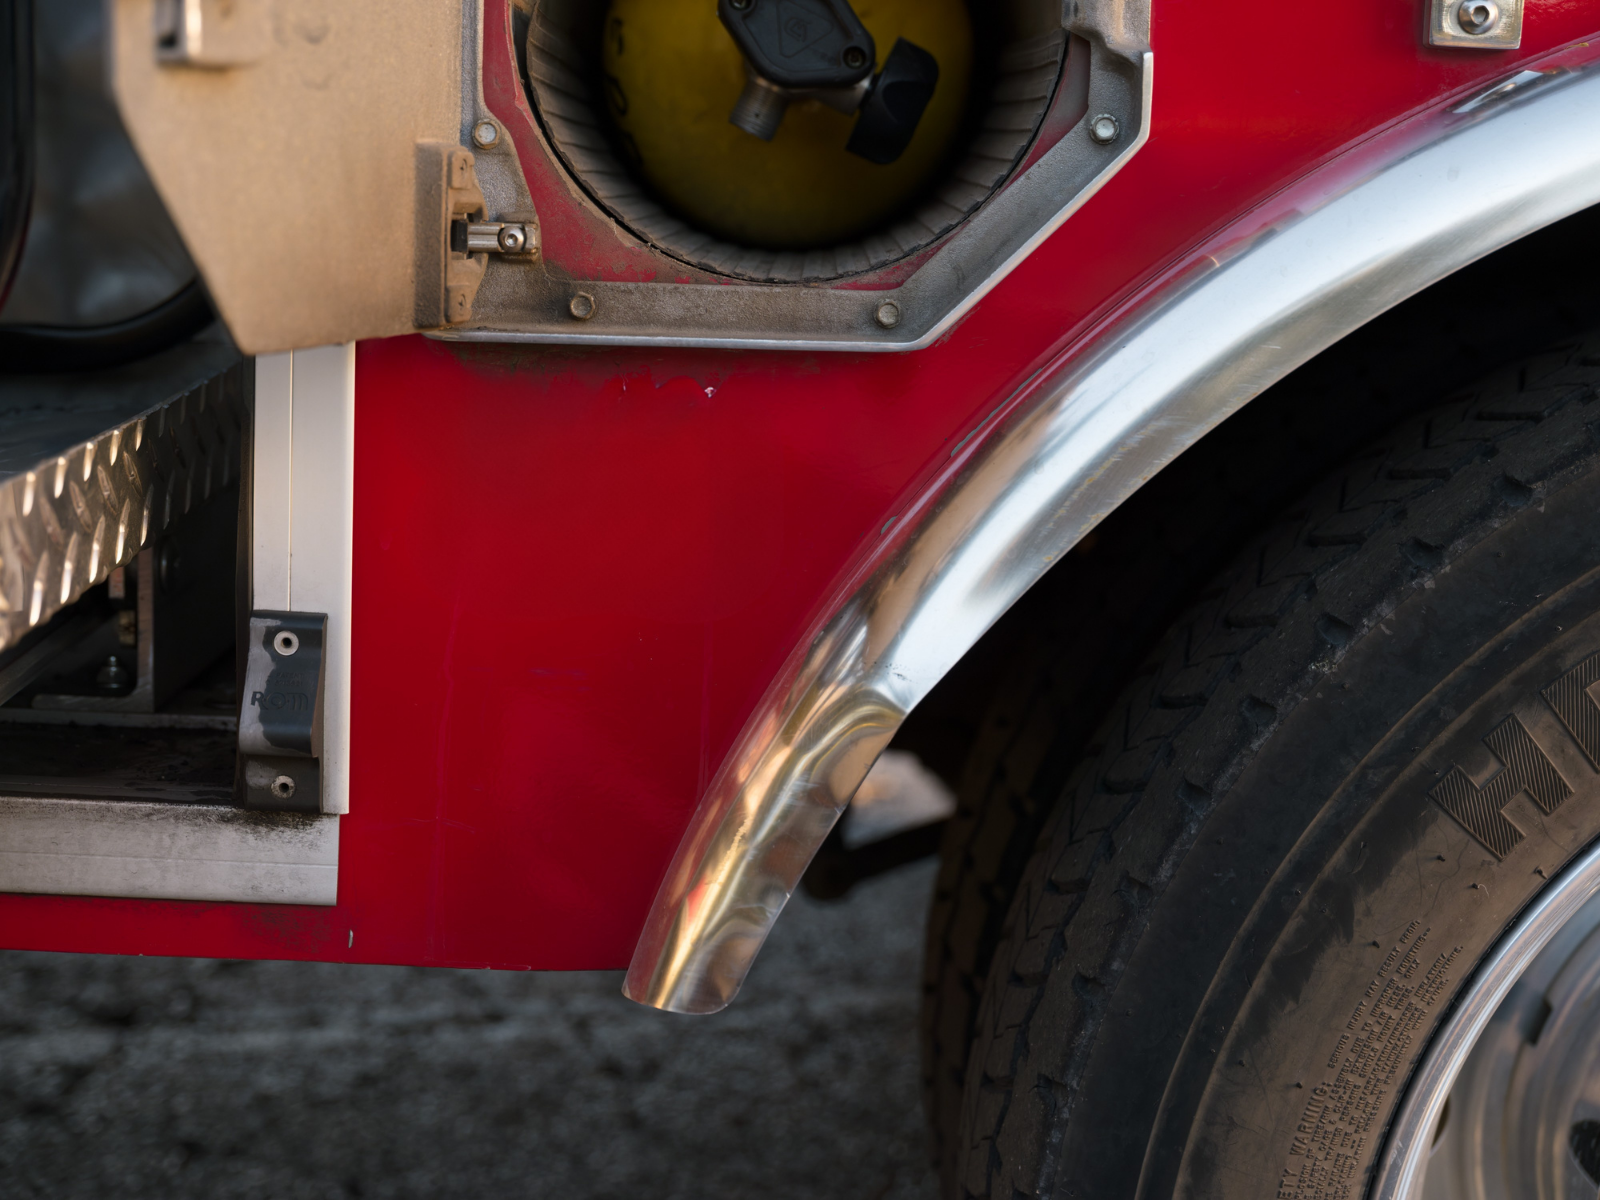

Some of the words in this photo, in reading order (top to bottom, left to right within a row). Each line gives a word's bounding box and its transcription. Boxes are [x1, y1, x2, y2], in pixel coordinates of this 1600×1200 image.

[1277, 1168, 1298, 1198] ETY
[1328, 1033, 1350, 1068] SERIOUS
[1347, 1001, 1367, 1030] INJURY
[1365, 981, 1379, 997] MAY
[1377, 947, 1400, 977] RESULT
[1307, 1149, 1316, 1159] OF
[1329, 1058, 1353, 1100] ASSEMBLY
[1351, 1037, 1363, 1053] DUE
[1362, 1021, 1372, 1032] TO
[1370, 978, 1397, 1017] IMPROPER
[1307, 1157, 1323, 1189] SAFETY
[1319, 1130, 1333, 1151] CAGE
[1351, 1029, 1378, 1075] EXTENSION
[1376, 1011, 1389, 1025] AIR
[1404, 960, 1420, 979] ONLY
[1340, 1084, 1361, 1122] PERSONS
[1359, 1047, 1379, 1078] SHOULD
[1377, 1016, 1395, 1042] MOUNT
[1341, 1132, 1352, 1148] DUE
[1349, 1115, 1359, 1126] TO
[1371, 1078, 1383, 1096] TIRE
